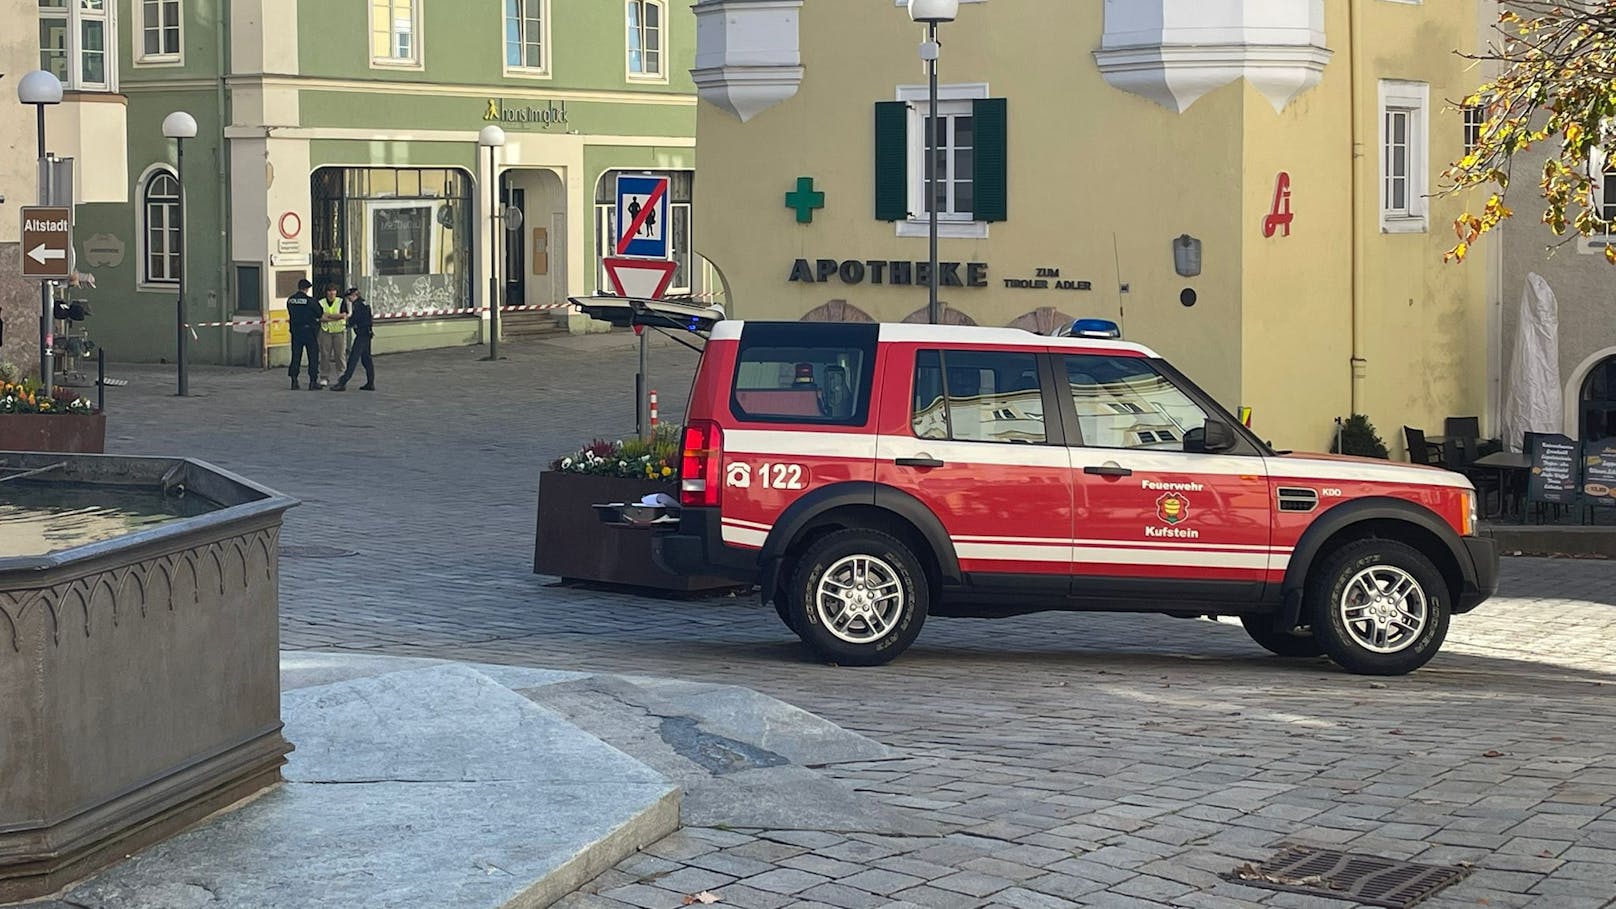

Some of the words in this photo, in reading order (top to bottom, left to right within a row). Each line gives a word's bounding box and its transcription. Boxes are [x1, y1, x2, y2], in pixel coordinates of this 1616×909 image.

[24, 219, 68, 231] Altstadt
[788, 259, 989, 287] APOTHEKE
[1035, 268, 1060, 277] ZUM
[1003, 279, 1048, 289] TIROLER
[1055, 280, 1092, 290] ADLER
[758, 463, 802, 489] 122
[1141, 479, 1204, 492] Feuerwehr
[1322, 487, 1342, 497] KDO
[1145, 526, 1199, 539] Kufstein
